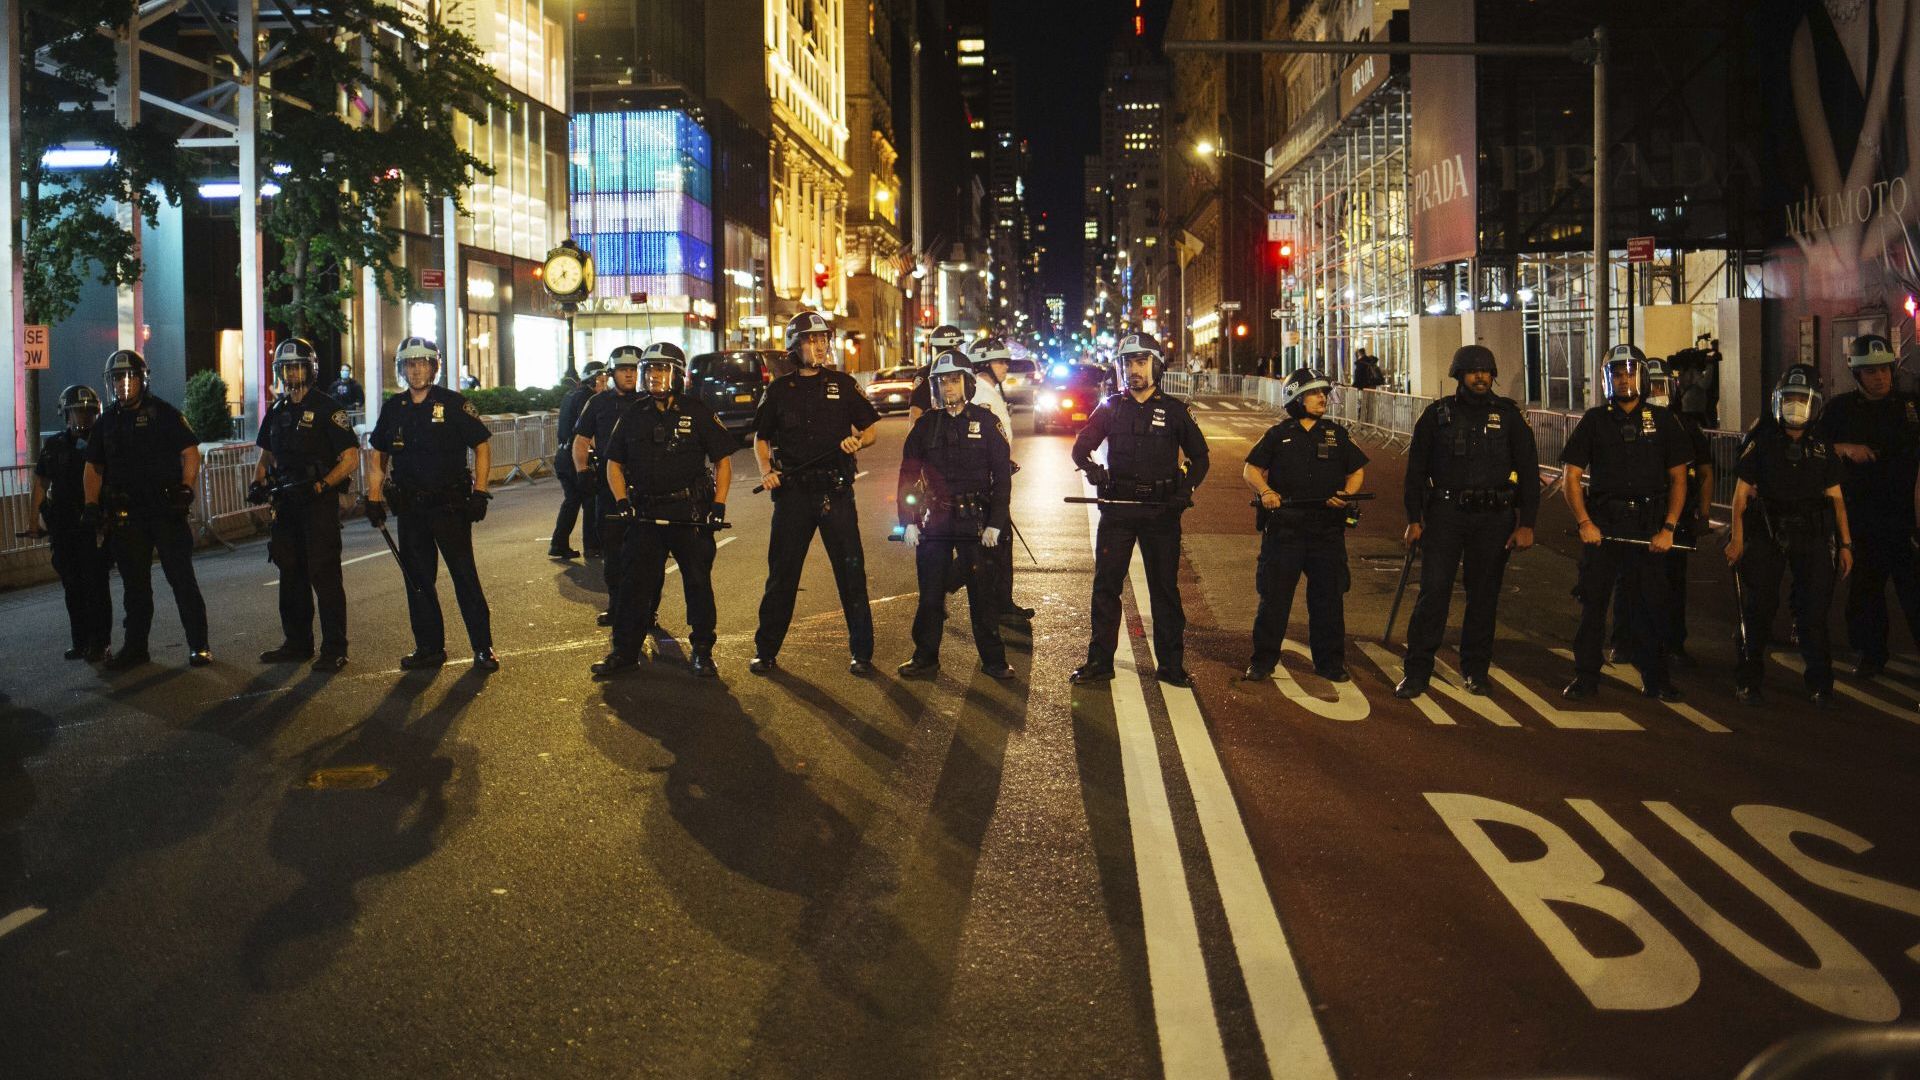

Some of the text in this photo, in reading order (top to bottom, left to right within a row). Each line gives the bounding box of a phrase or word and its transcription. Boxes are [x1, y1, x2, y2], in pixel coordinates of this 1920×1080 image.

[1352, 56, 1374, 97] PRADA
[1415, 154, 1469, 214] PRADA
[1785, 177, 1907, 237] MIKIMOTO
[1421, 791, 1920, 1022] BUS
